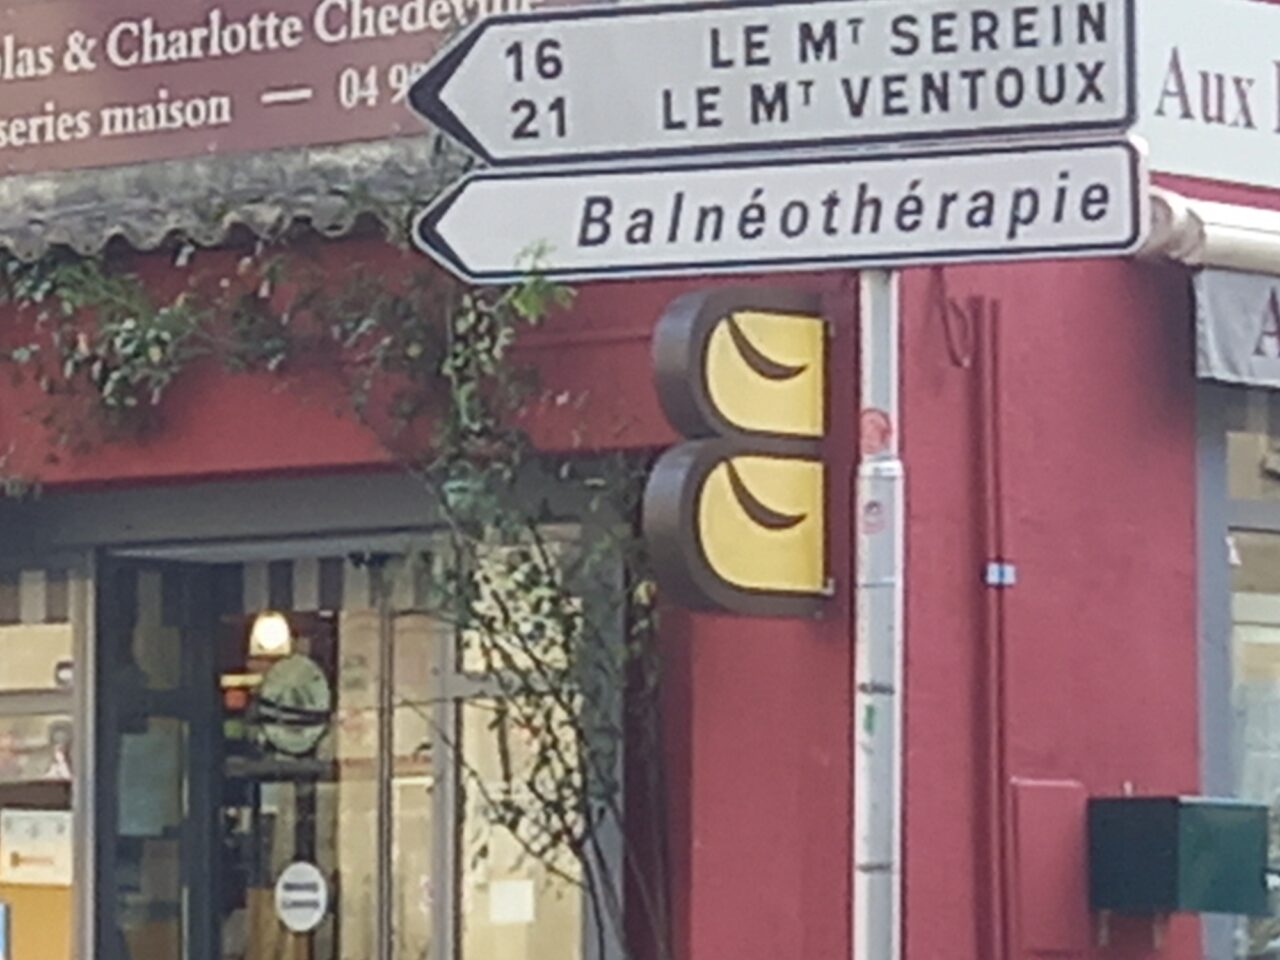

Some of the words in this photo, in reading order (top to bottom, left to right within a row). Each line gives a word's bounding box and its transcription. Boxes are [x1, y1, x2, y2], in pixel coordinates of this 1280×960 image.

[63, 30, 97, 72] &
[106, 8, 303, 67] Charlotte
[505, 38, 563, 81] 16
[710, 26, 770, 68] LE
[890, 3, 1107, 56] SEREIN
[99, 88, 232, 136] maison
[339, 66, 379, 109] 04
[510, 96, 566, 139] 21
[662, 87, 723, 129] LE
[840, 61, 1106, 118] VENTOUX
[1154, 46, 1257, 129] Aux
[577, 171, 1110, 247] Balnéothérapie
